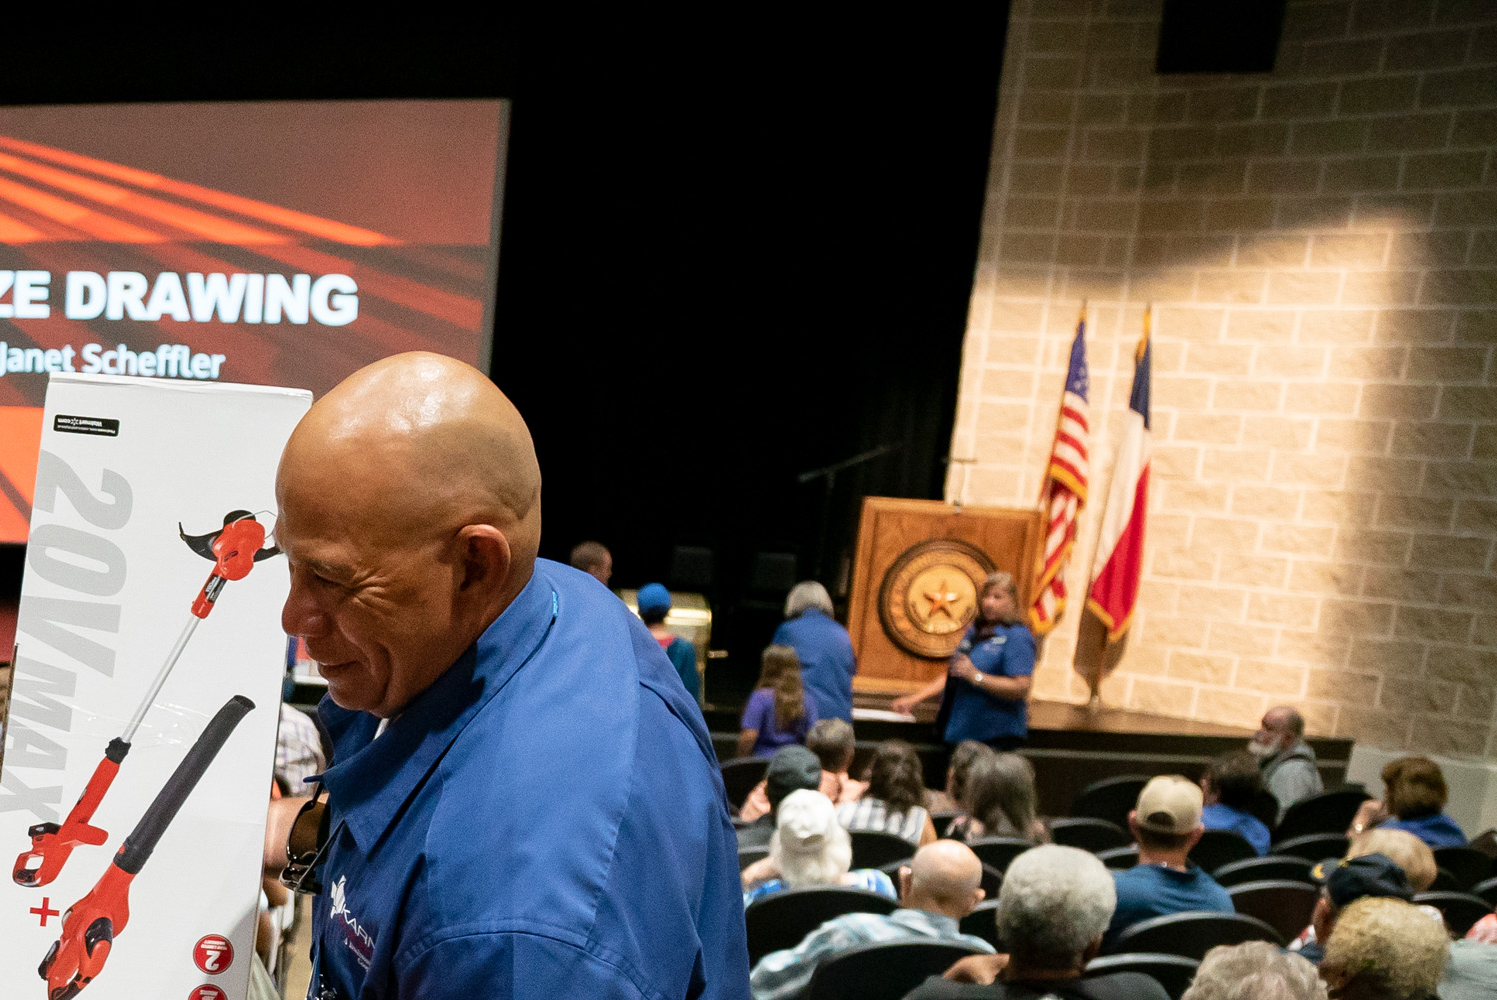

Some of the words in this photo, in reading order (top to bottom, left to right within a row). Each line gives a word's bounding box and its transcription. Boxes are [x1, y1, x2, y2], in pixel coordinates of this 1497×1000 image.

[65, 271, 359, 326] DRAWING
[81, 343, 225, 379] Scheffler
[204, 950, 221, 971] 2
